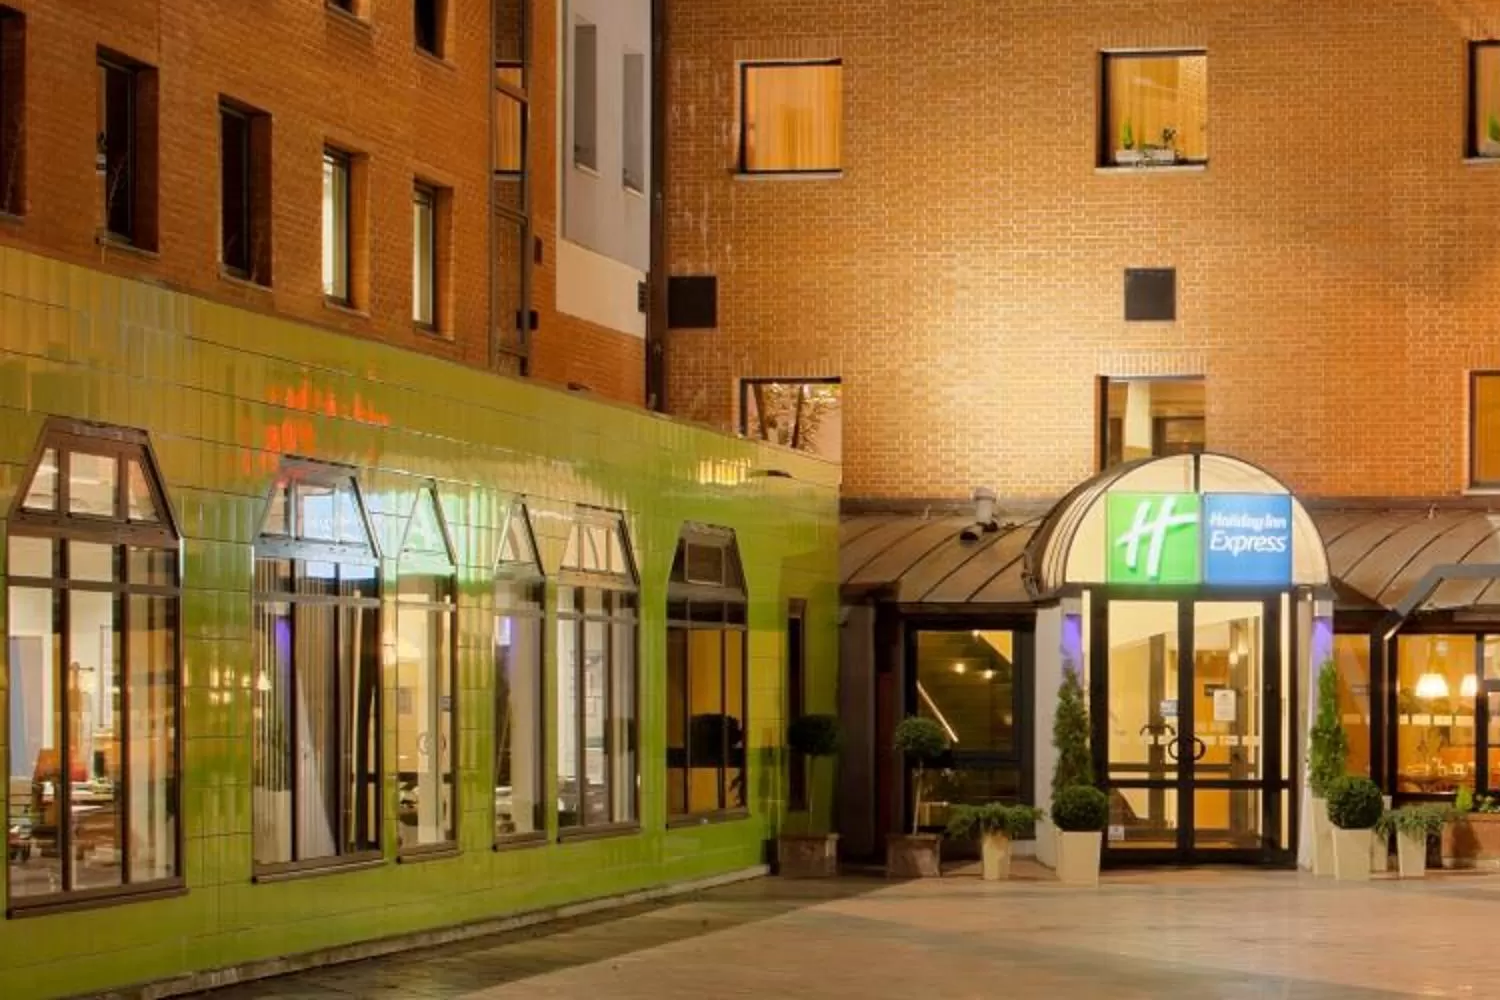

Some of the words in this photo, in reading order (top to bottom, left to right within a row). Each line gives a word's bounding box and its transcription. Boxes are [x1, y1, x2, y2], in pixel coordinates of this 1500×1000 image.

[1210, 511, 1263, 533] Holiday
[1264, 513, 1287, 529] Inn
[1210, 529, 1288, 557] Express
